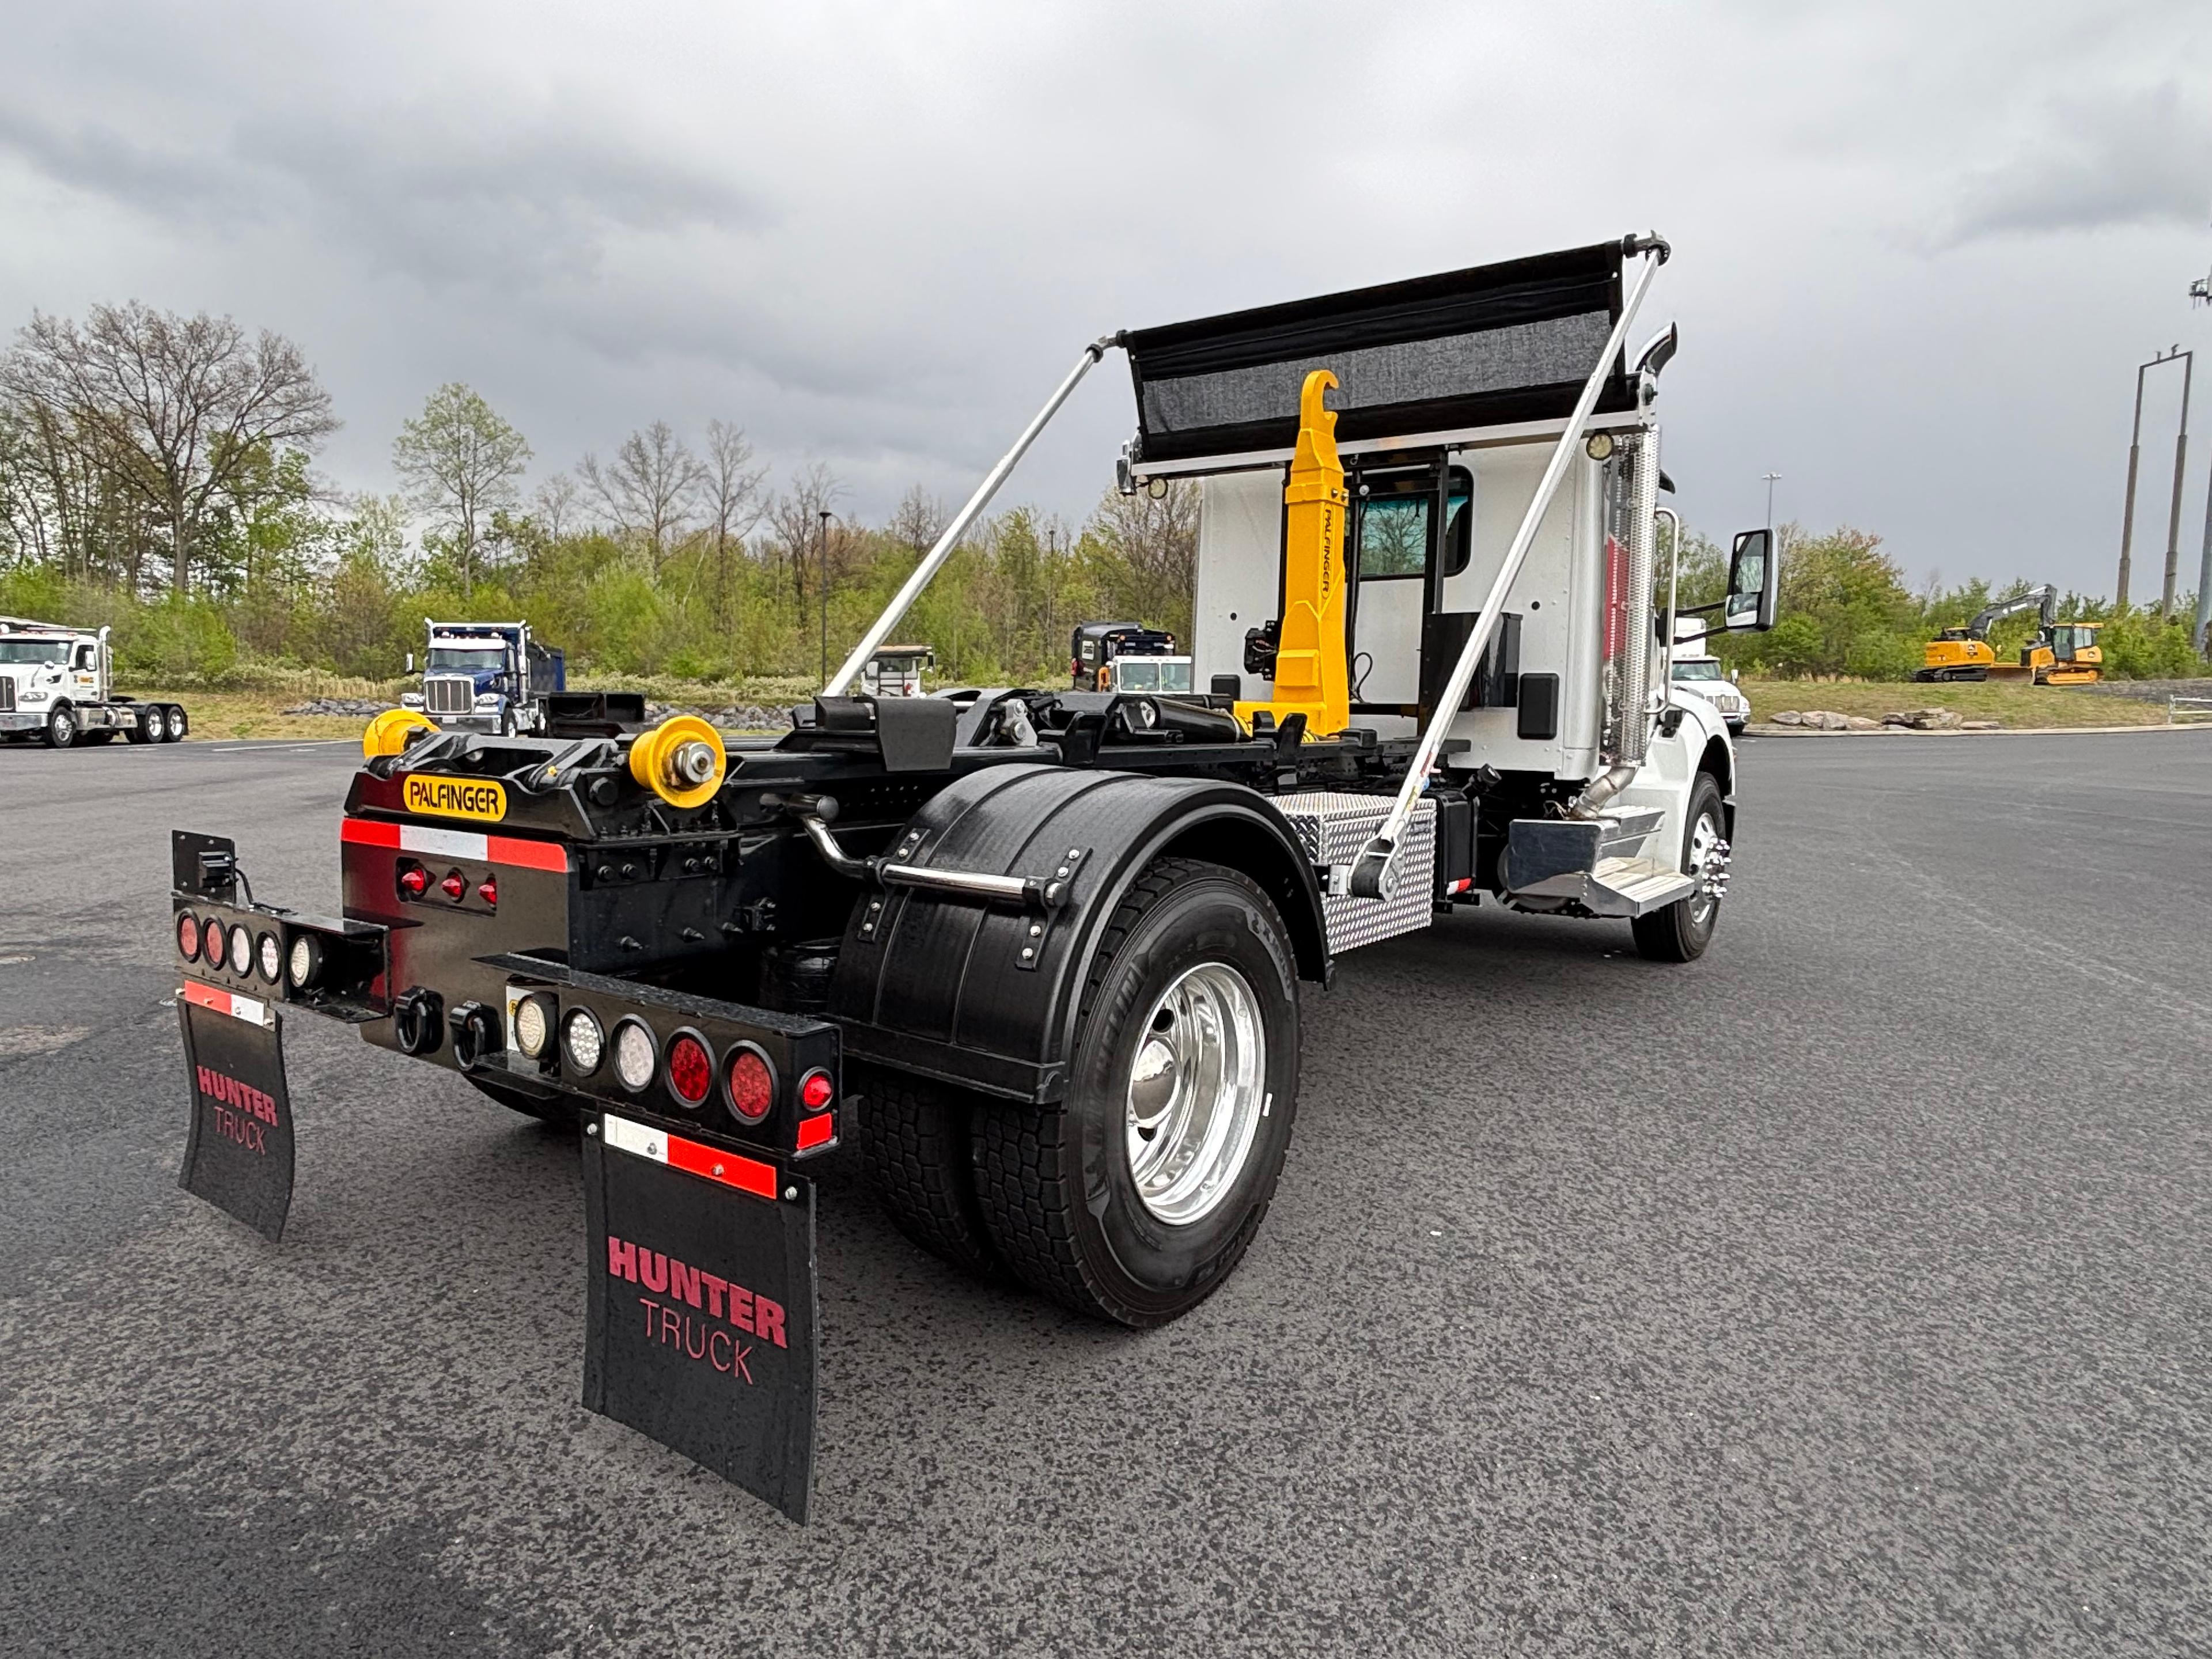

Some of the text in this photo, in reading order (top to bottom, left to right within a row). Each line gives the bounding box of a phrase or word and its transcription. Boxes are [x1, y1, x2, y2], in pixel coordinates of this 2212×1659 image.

[1322, 509, 1332, 592] PALFINGER
[410, 781, 499, 815] PALFINGER
[196, 1065, 278, 1127] HUNTER
[214, 1106, 266, 1156] TRUCK
[608, 1236, 788, 1349] HUNTER
[639, 1298, 753, 1385] TRUCK
